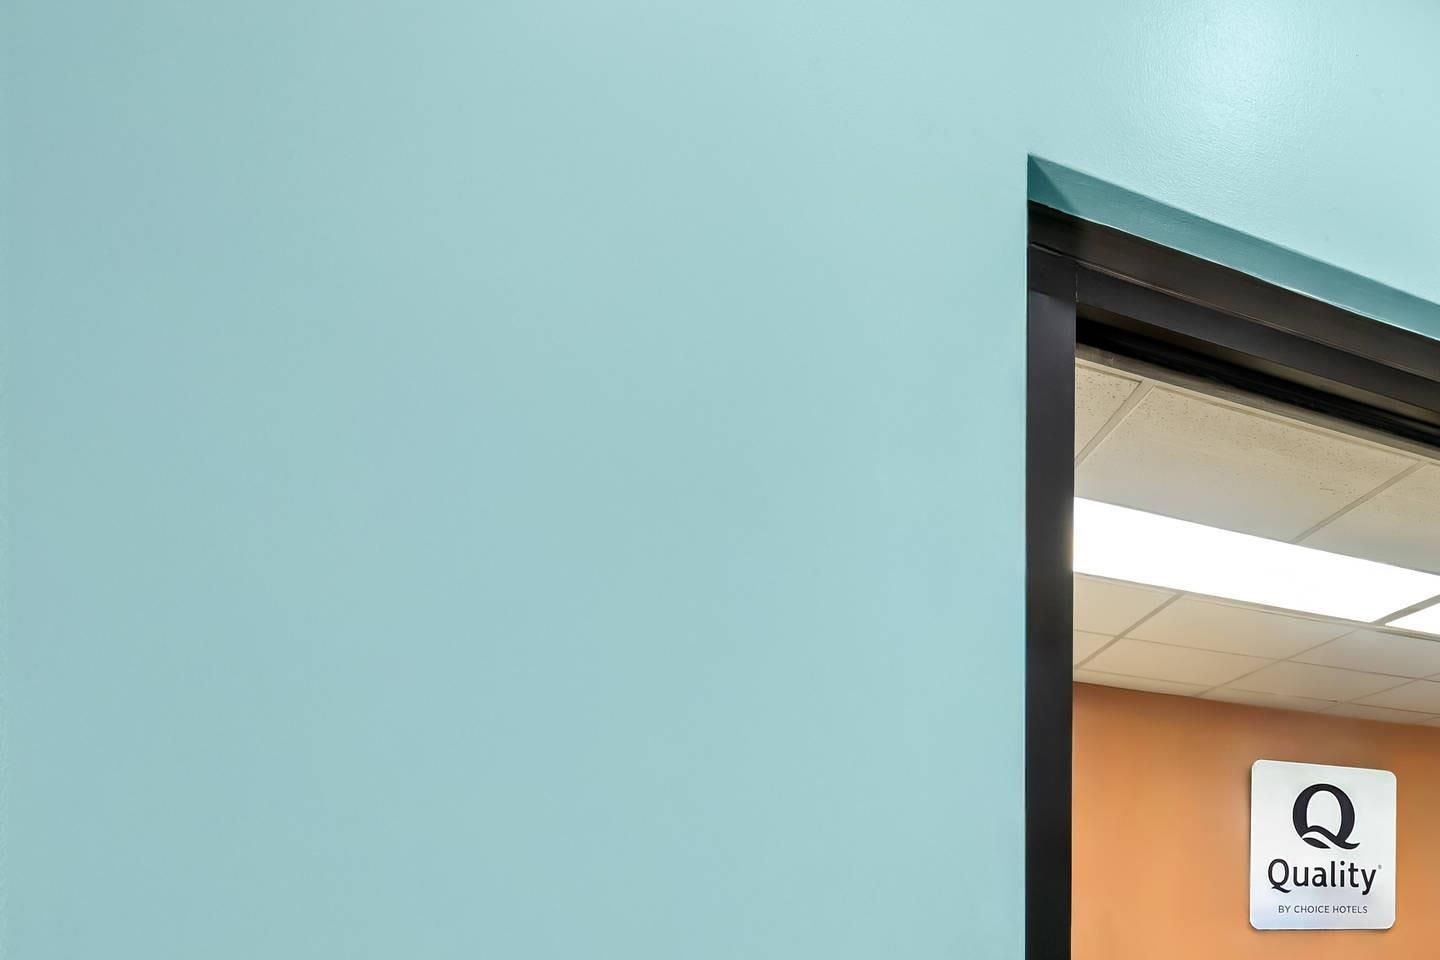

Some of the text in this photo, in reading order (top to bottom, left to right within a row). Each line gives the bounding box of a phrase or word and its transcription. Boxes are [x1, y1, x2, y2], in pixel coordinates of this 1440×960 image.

[1292, 783, 1361, 850] Q
[1267, 858, 1378, 896] Quality
[1278, 904, 1368, 914] BY CHOICE HOTELS
